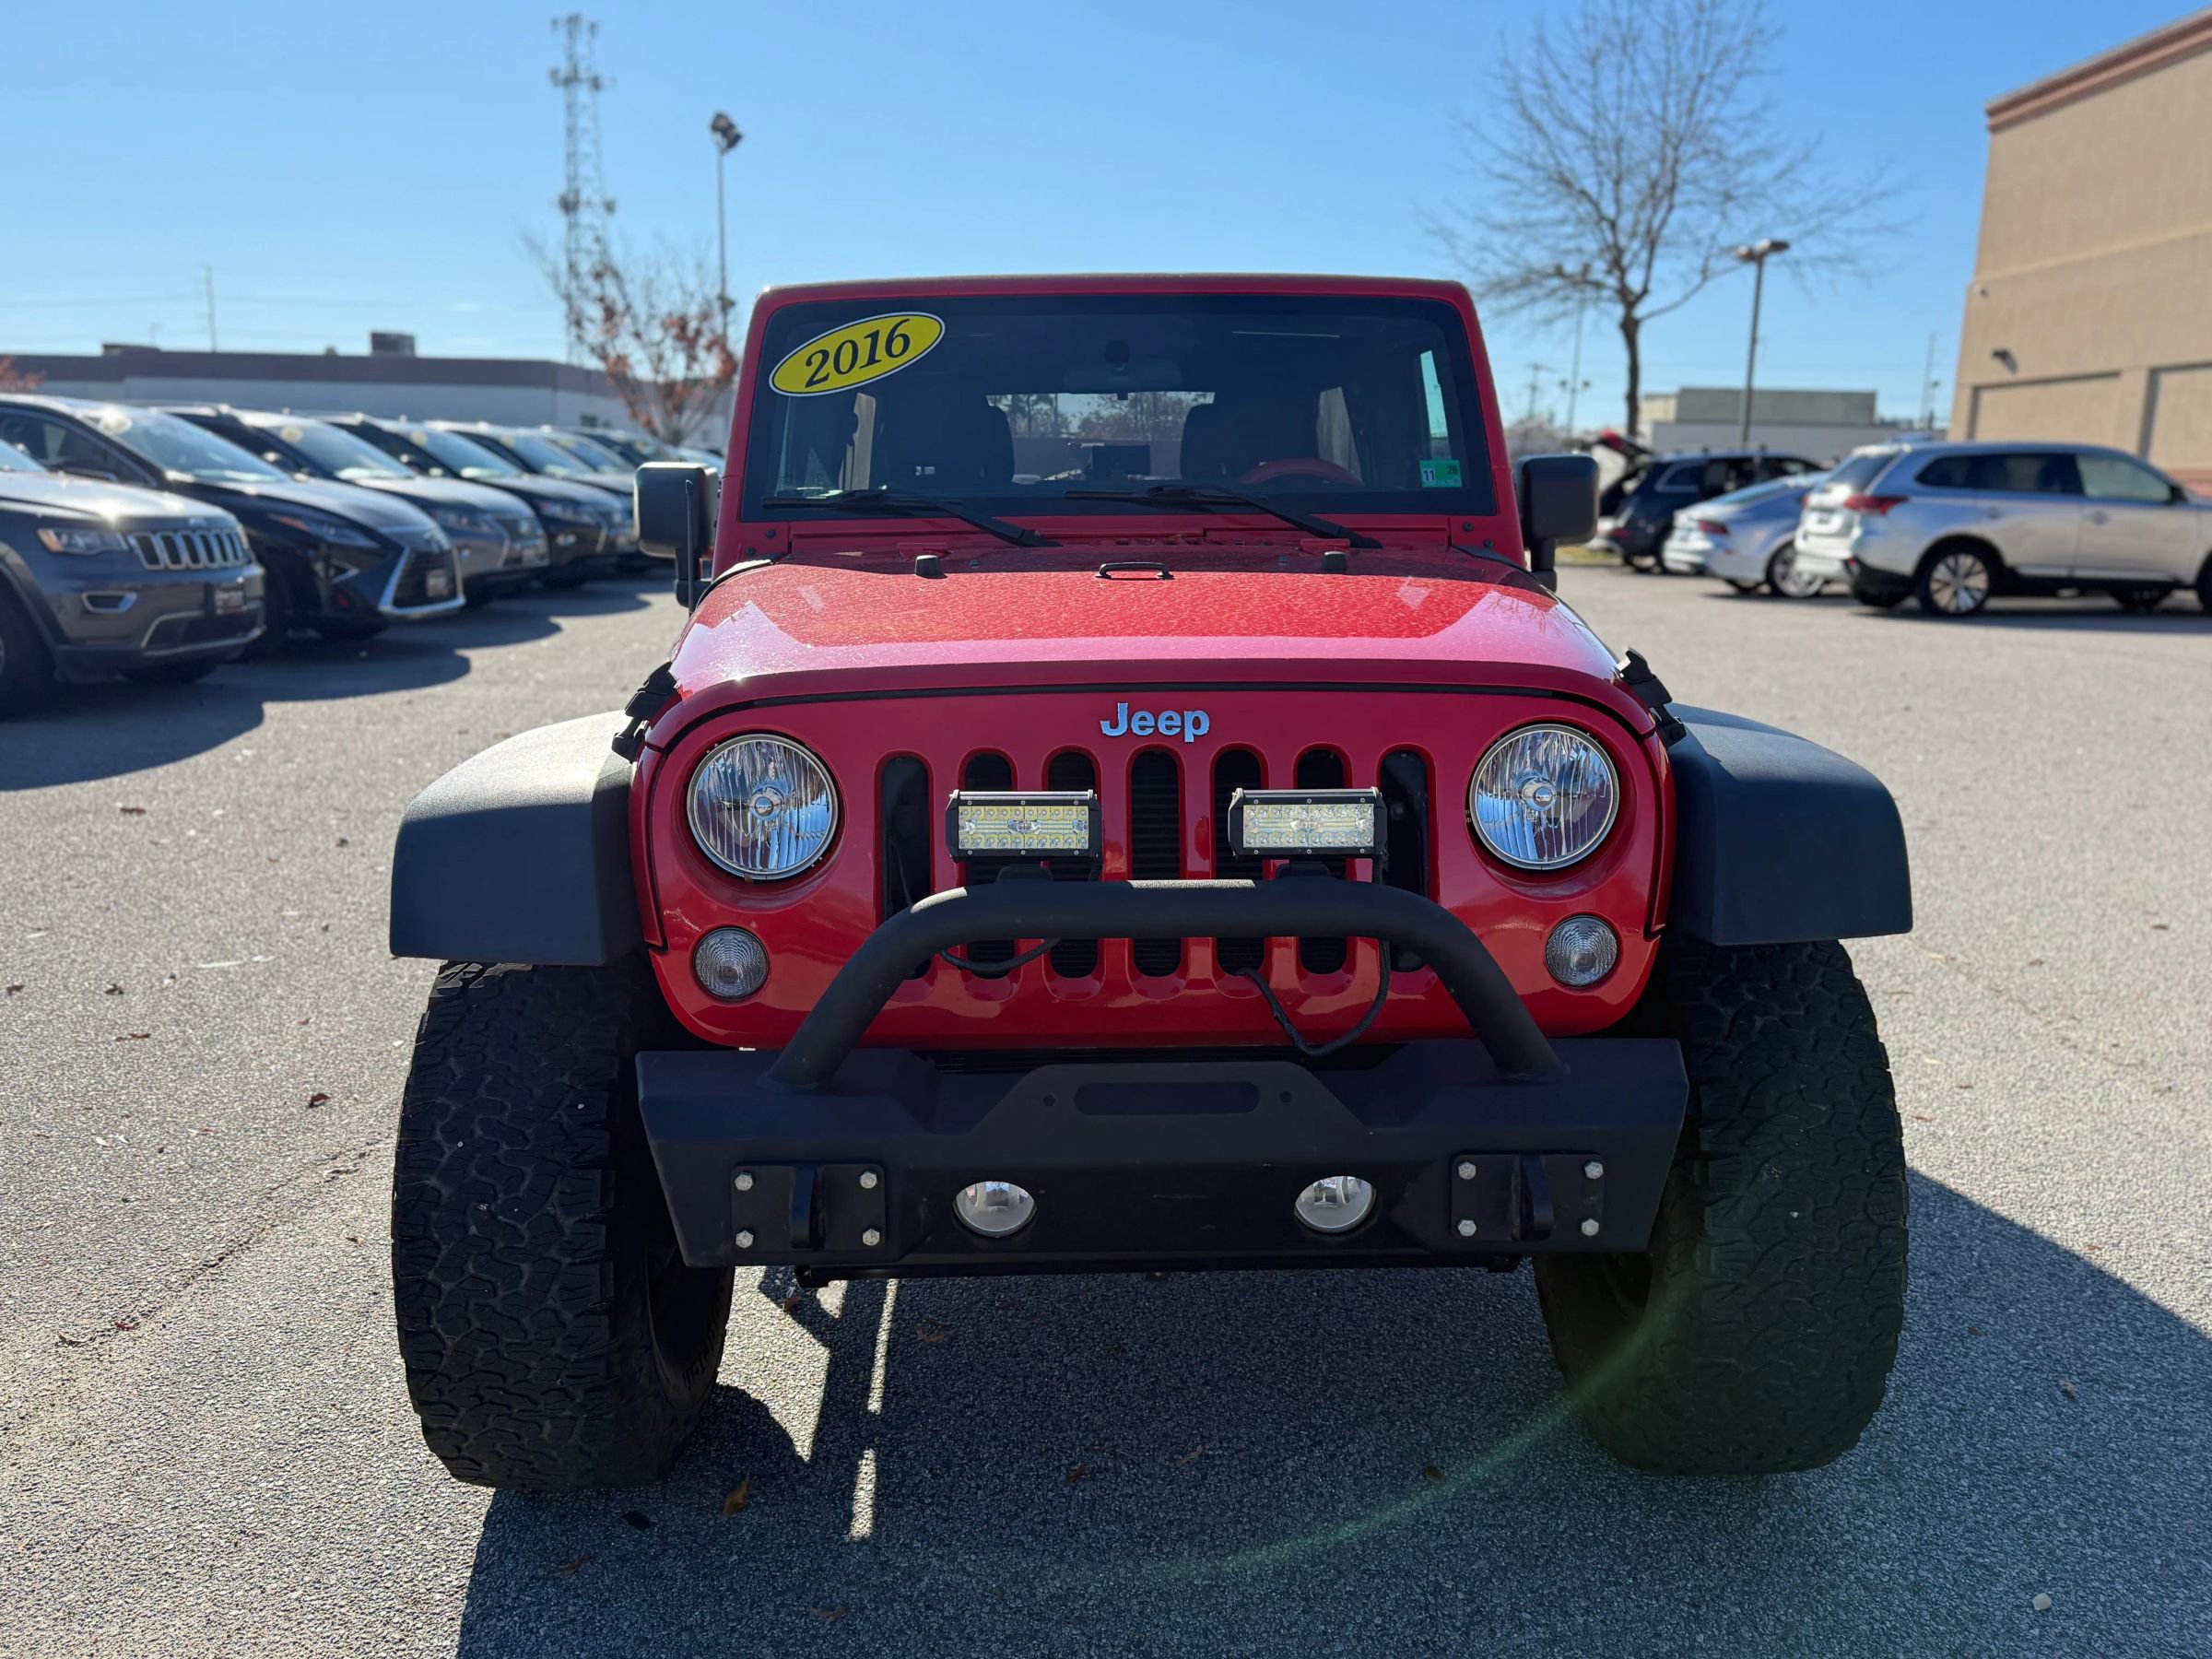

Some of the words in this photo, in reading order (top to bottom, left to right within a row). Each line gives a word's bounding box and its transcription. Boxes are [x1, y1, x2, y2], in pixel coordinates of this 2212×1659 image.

[805, 319, 911, 388] 2016
[1423, 470, 1435, 481] 11
[1100, 702, 1209, 743] Jeep
